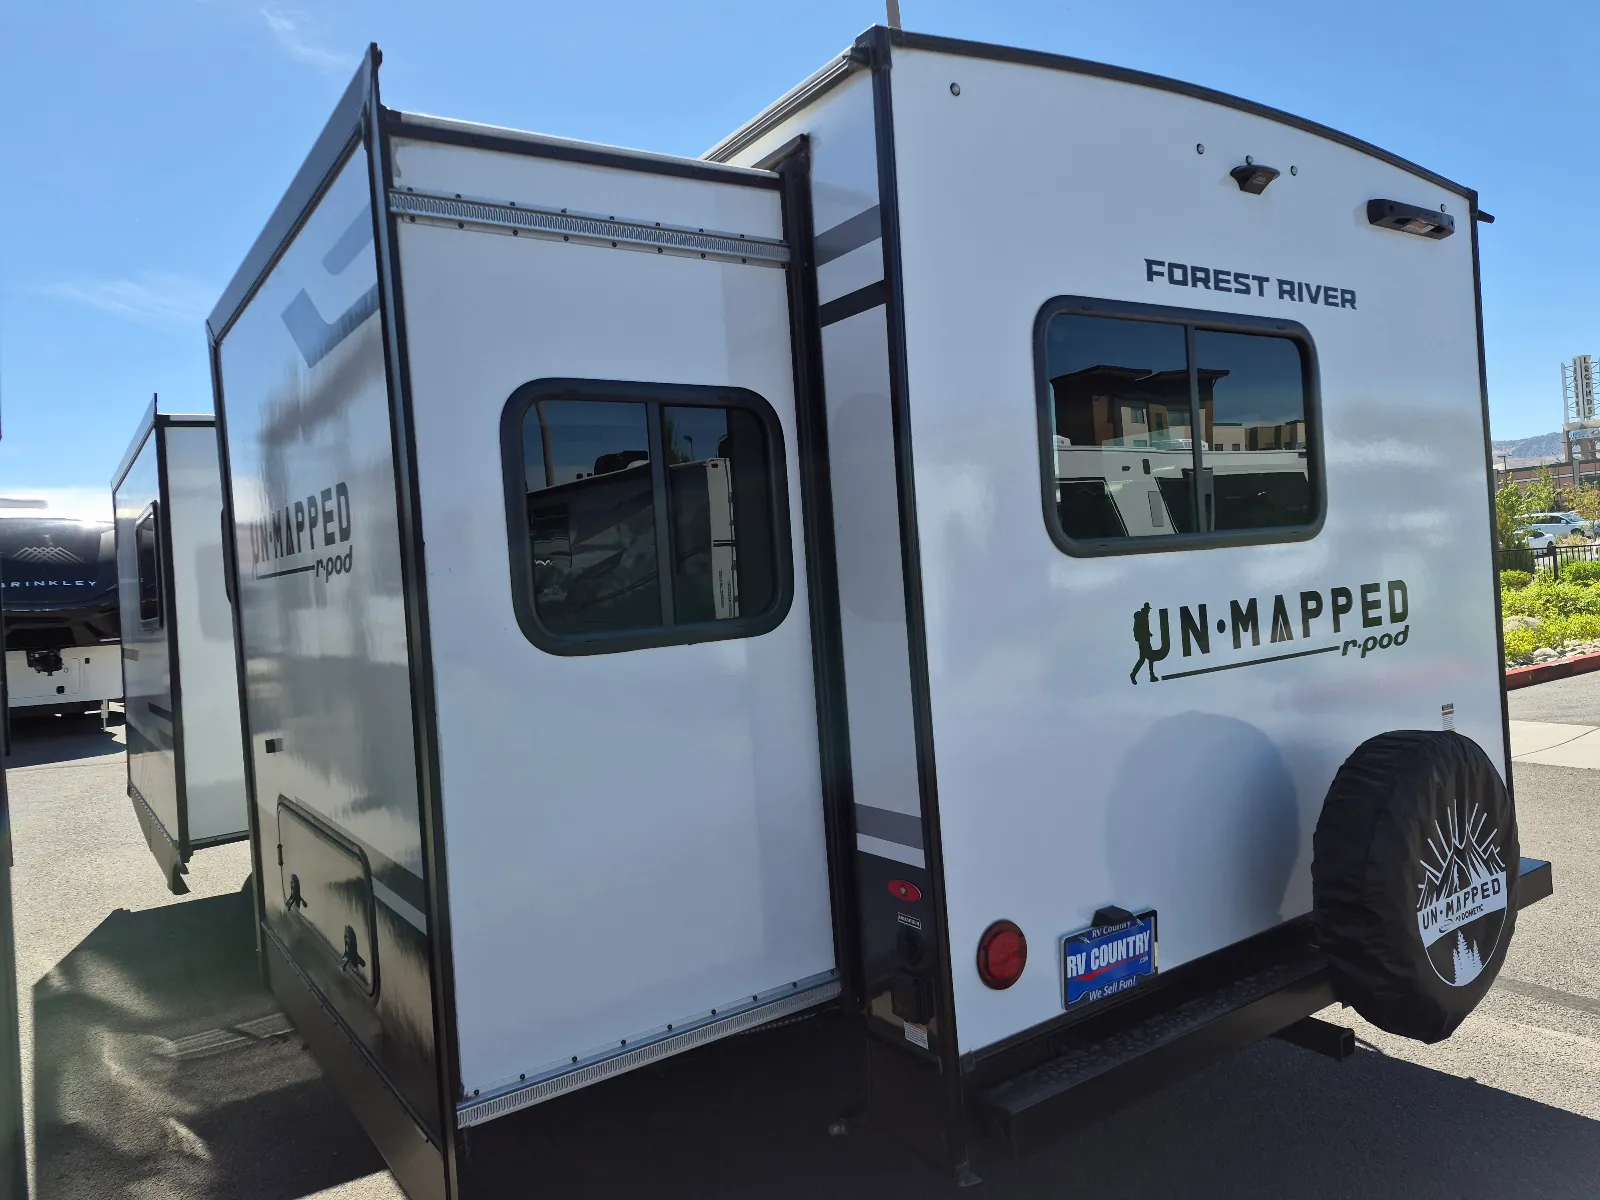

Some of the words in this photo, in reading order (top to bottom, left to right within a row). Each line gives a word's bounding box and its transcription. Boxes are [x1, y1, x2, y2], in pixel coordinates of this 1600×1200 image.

[1144, 258, 1270, 298] FOREST
[1276, 278, 1357, 310] RIVER
[1092, 928, 1102, 938] RV
[1067, 952, 1086, 978] RV
[1090, 930, 1150, 971] COUNTRY
[1089, 990, 1102, 1001] We
[1103, 982, 1117, 997] Sell
[1119, 976, 1136, 990] Fun!
